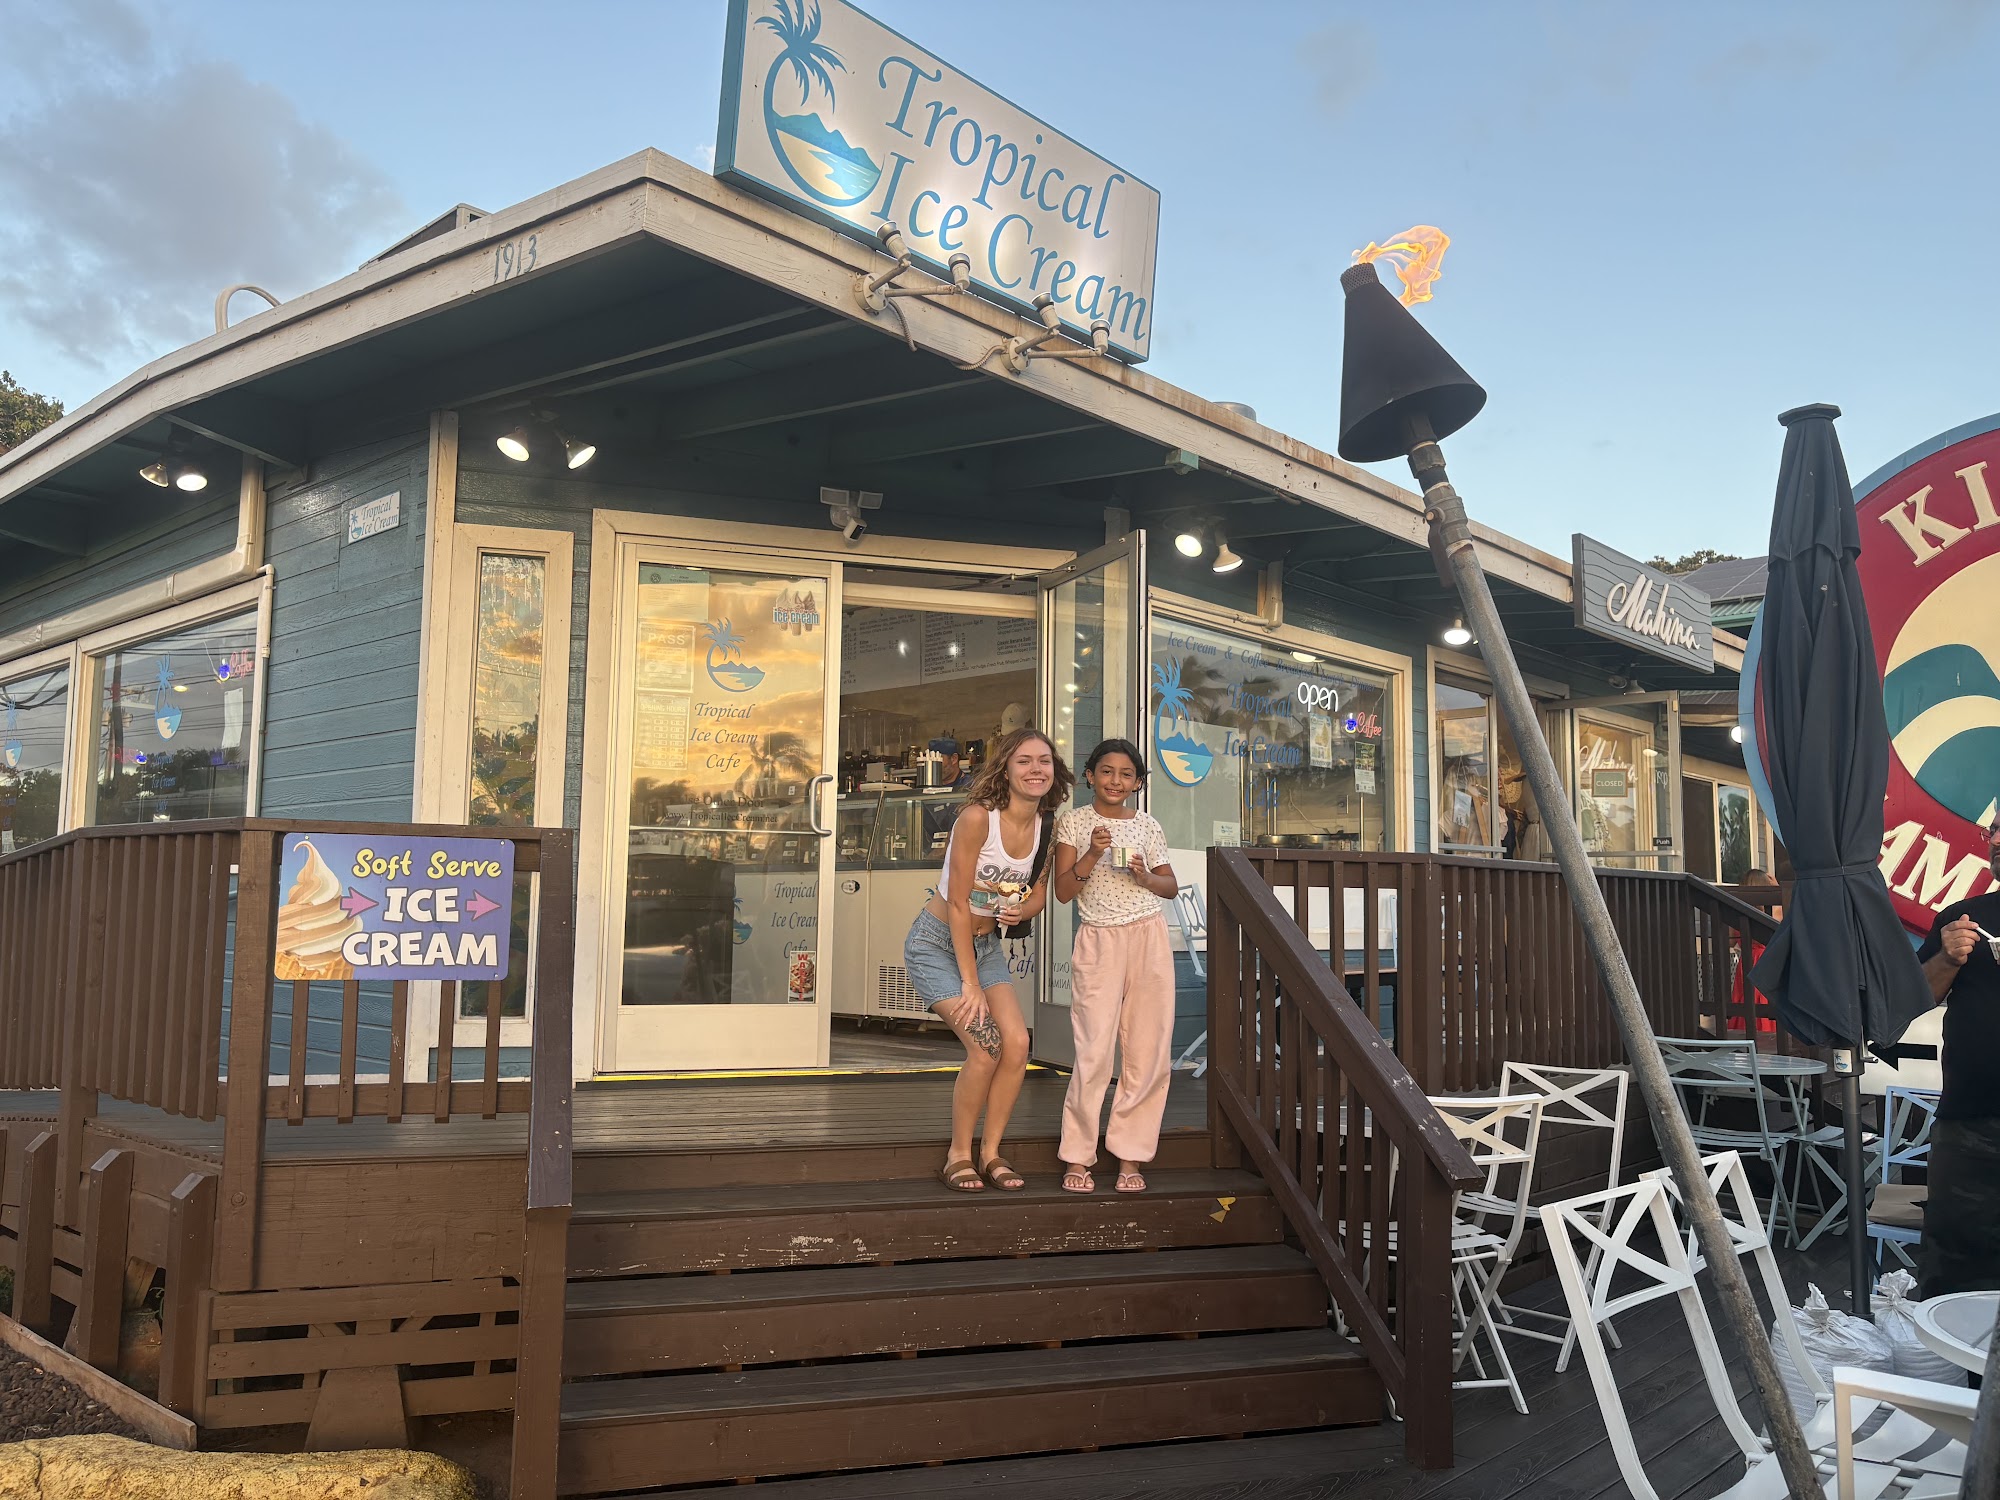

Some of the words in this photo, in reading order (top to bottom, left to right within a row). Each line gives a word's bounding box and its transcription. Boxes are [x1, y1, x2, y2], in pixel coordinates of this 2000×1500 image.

[878, 55, 1125, 239] Tropical
[494, 234, 537, 285] 1913
[871, 151, 970, 250] Ice
[987, 213, 1147, 340] Cream
[361, 494, 394, 522] Tropical
[361, 522, 373, 536] Ice
[374, 514, 398, 533] Cream
[774, 608, 788, 623] ice
[790, 611, 819, 625] cream
[1606, 573, 1700, 650] Mahina
[648, 632, 686, 646] PASS
[1167, 631, 1184, 648] Ice
[1185, 635, 1217, 656] Cream
[1224, 645, 1233, 660] &
[1241, 649, 1269, 669] Coffee
[694, 702, 755, 722] Tropical
[1227, 682, 1295, 722] Tropical
[1297, 682, 1339, 713] open
[689, 728, 712, 742] Ice
[715, 728, 758, 745] Cream
[1356, 711, 1383, 739] Coffee
[706, 752, 741, 773] Cafe
[1222, 731, 1248, 758] Ice
[1252, 735, 1300, 767] Cream
[1245, 777, 1281, 816] Cafe
[1595, 780, 1623, 788] CLOSED
[352, 848, 413, 881] Soft
[426, 850, 502, 880] Serve
[383, 887, 460, 924] ICE
[774, 881, 819, 903] Tropical
[771, 912, 787, 928] Ice
[341, 932, 498, 967] CREAM
